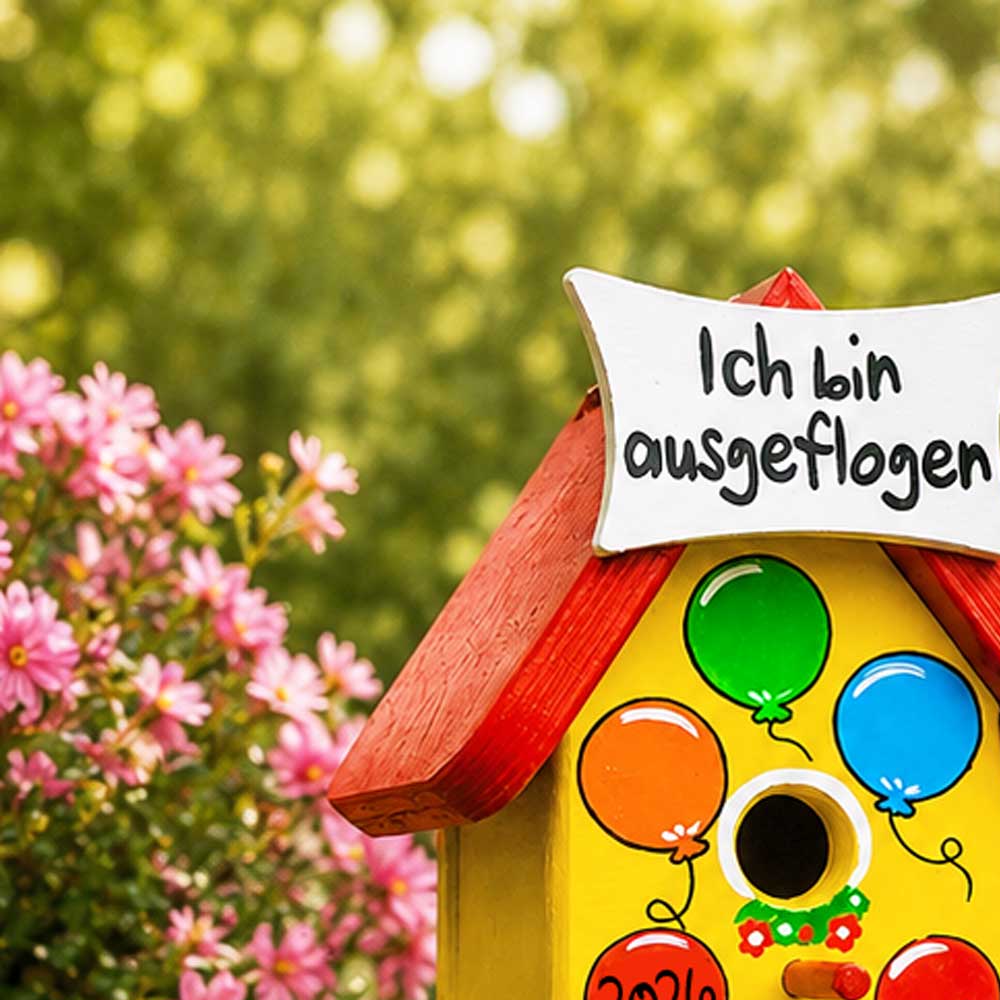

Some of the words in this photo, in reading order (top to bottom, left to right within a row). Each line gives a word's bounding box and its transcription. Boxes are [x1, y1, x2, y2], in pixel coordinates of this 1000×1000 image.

[699, 322, 793, 400] Ich
[813, 333, 902, 402] bin
[623, 410, 993, 512] ausgeflogen
